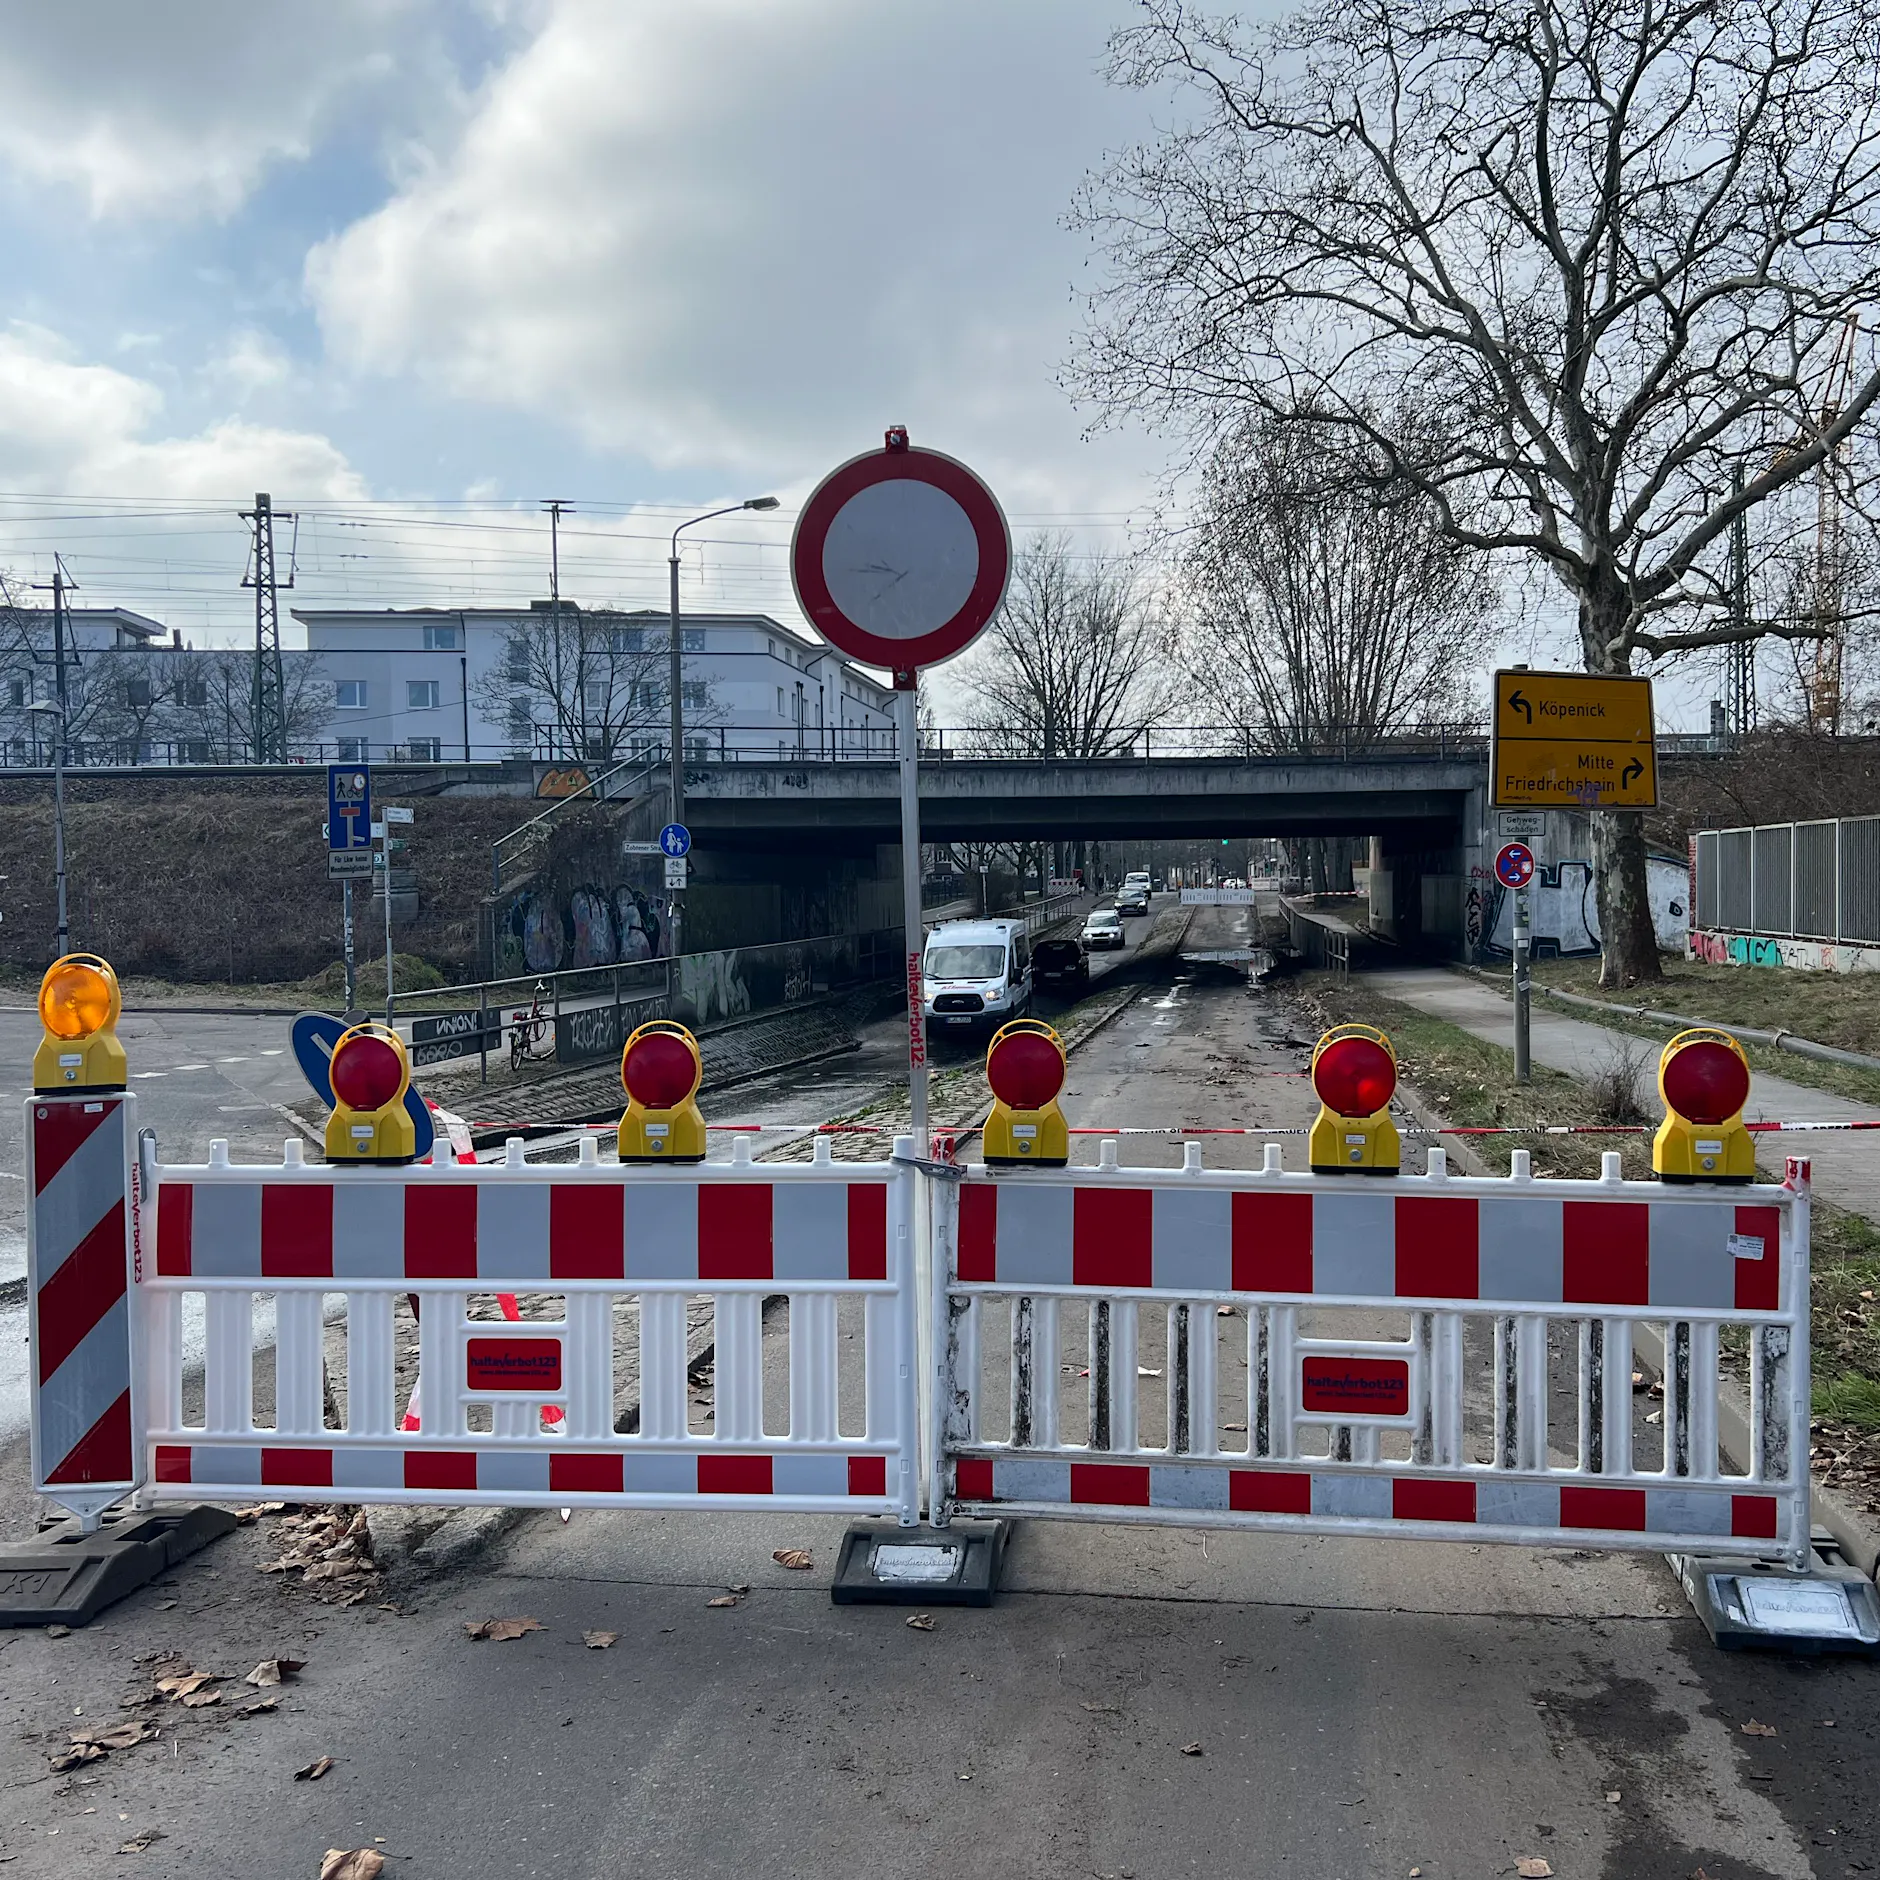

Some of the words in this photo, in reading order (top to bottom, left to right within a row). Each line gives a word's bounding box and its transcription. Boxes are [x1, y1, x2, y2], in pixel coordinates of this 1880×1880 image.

[1539, 700, 1606, 719] Köpenick
[1578, 754, 1614, 770] Mitte
[1505, 775, 1615, 792] Friedrichshain
[1506, 816, 1541, 825] Gehweg-
